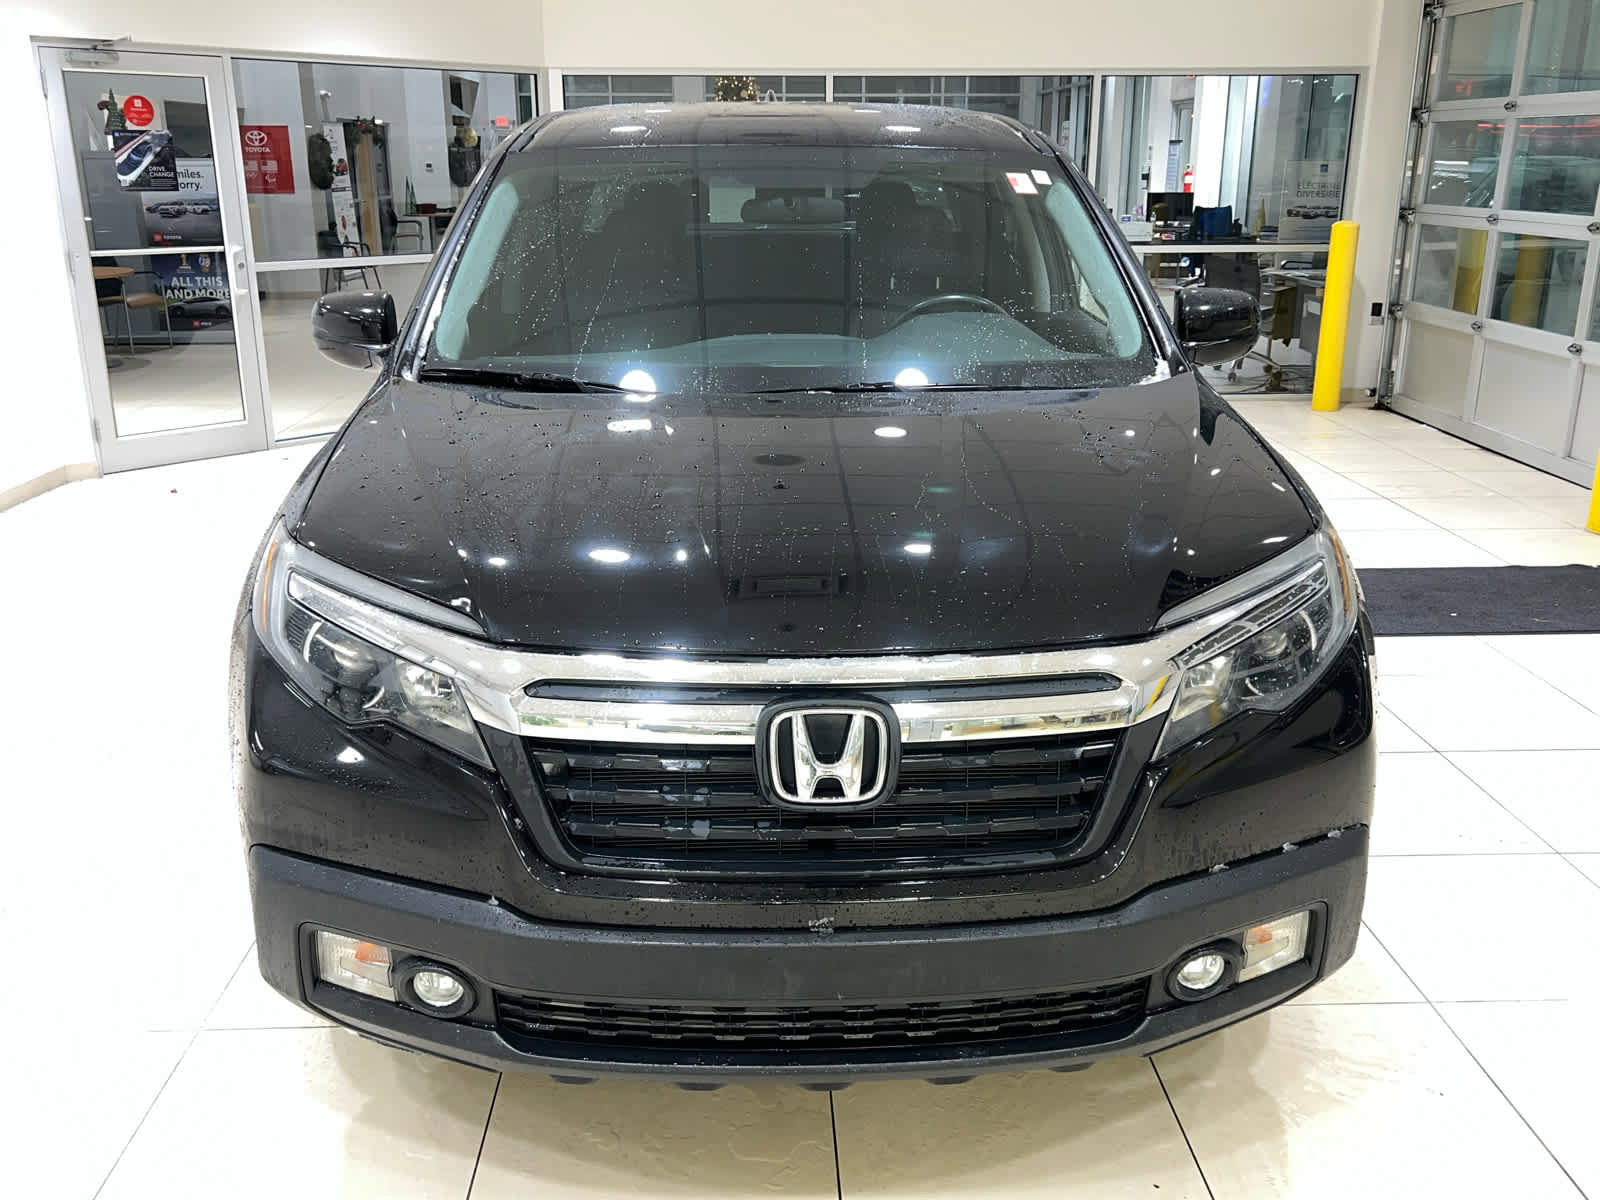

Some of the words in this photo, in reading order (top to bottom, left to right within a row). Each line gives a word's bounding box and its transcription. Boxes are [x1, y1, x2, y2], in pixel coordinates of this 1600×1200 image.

[179, 182, 203, 191] orry.
[171, 276, 193, 287] ALL
[195, 276, 223, 287] THIS
[166, 288, 193, 299] AND
[194, 288, 230, 298] MORE
